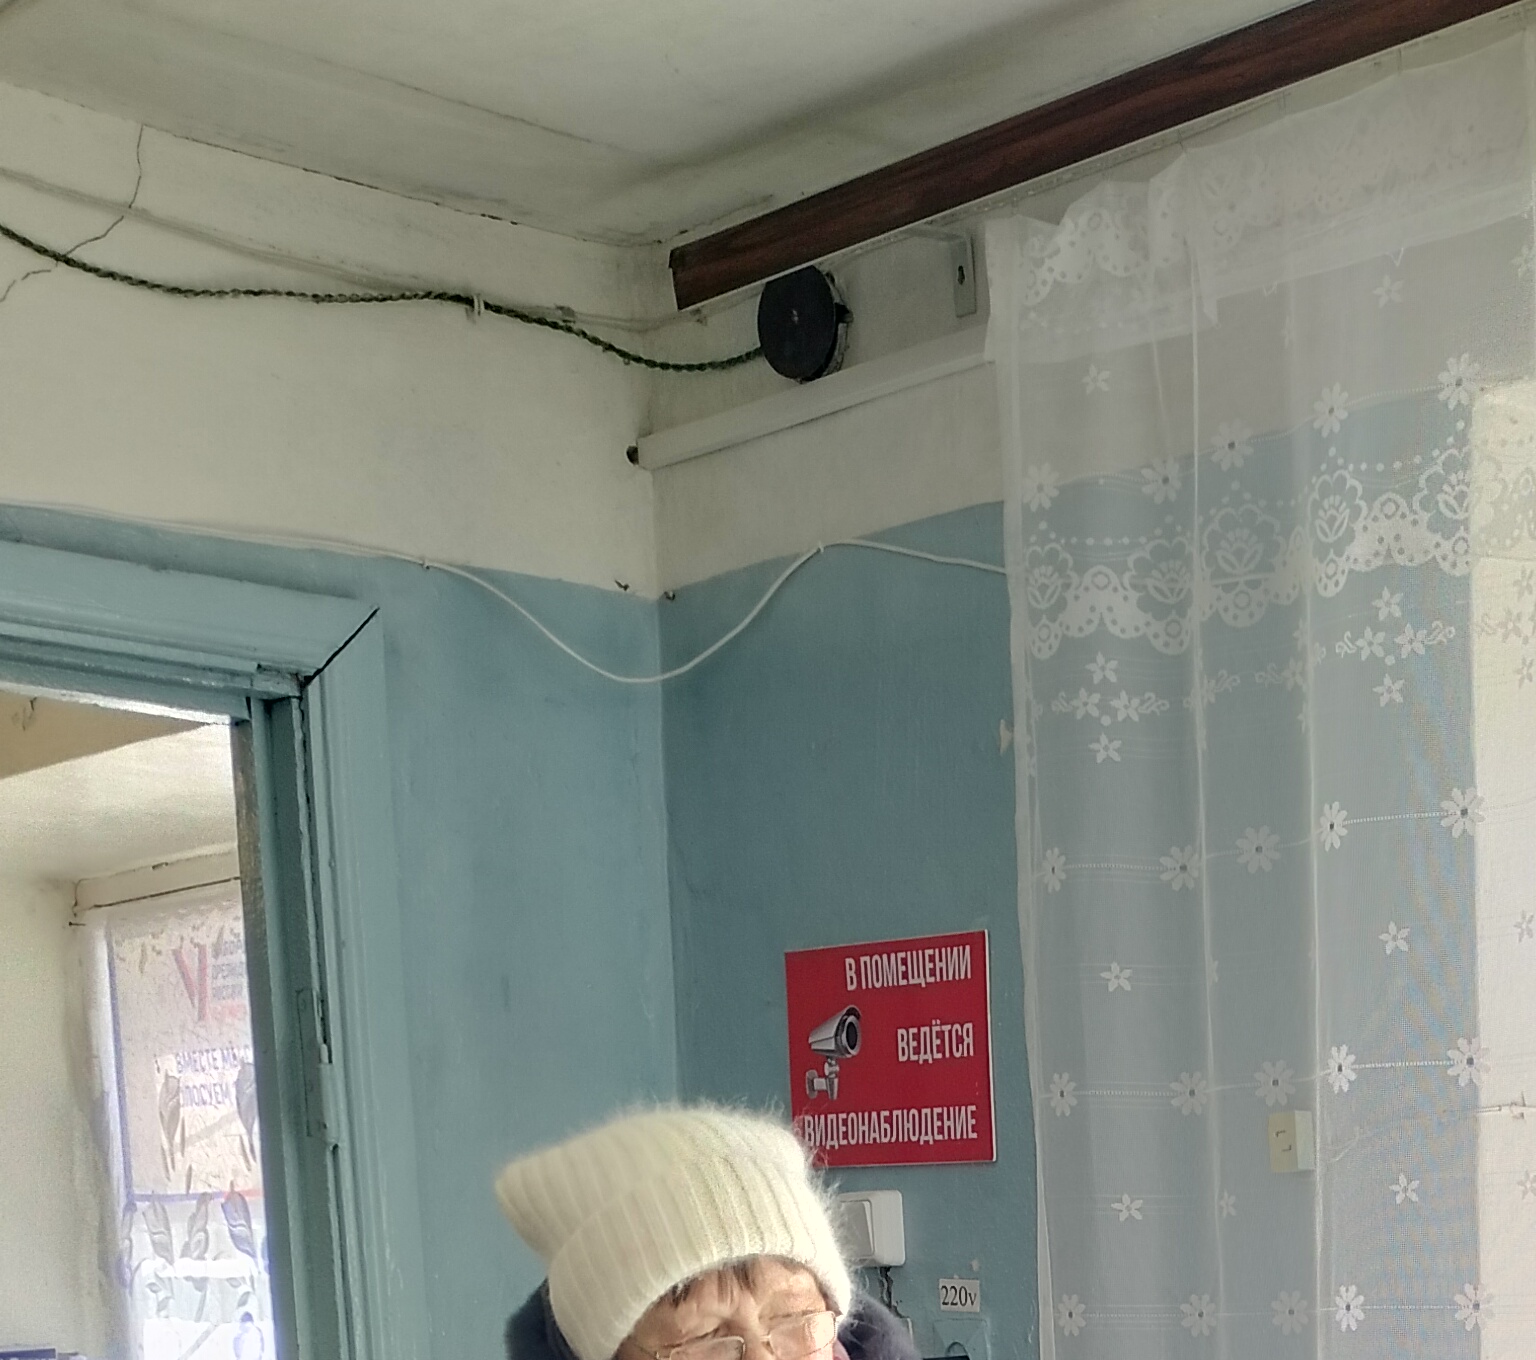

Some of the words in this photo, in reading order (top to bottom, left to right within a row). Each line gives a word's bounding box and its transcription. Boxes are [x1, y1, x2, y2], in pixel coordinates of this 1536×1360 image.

[845, 957, 857, 991] В
[860, 945, 971, 989] ПОМЕЩЕНИИ
[897, 1018, 974, 1064] ВЕДЁТСЯ
[803, 1105, 978, 1150] ВИДЕОНАБЛЮДЕНИЕ
[941, 1285, 977, 1306] 220v
